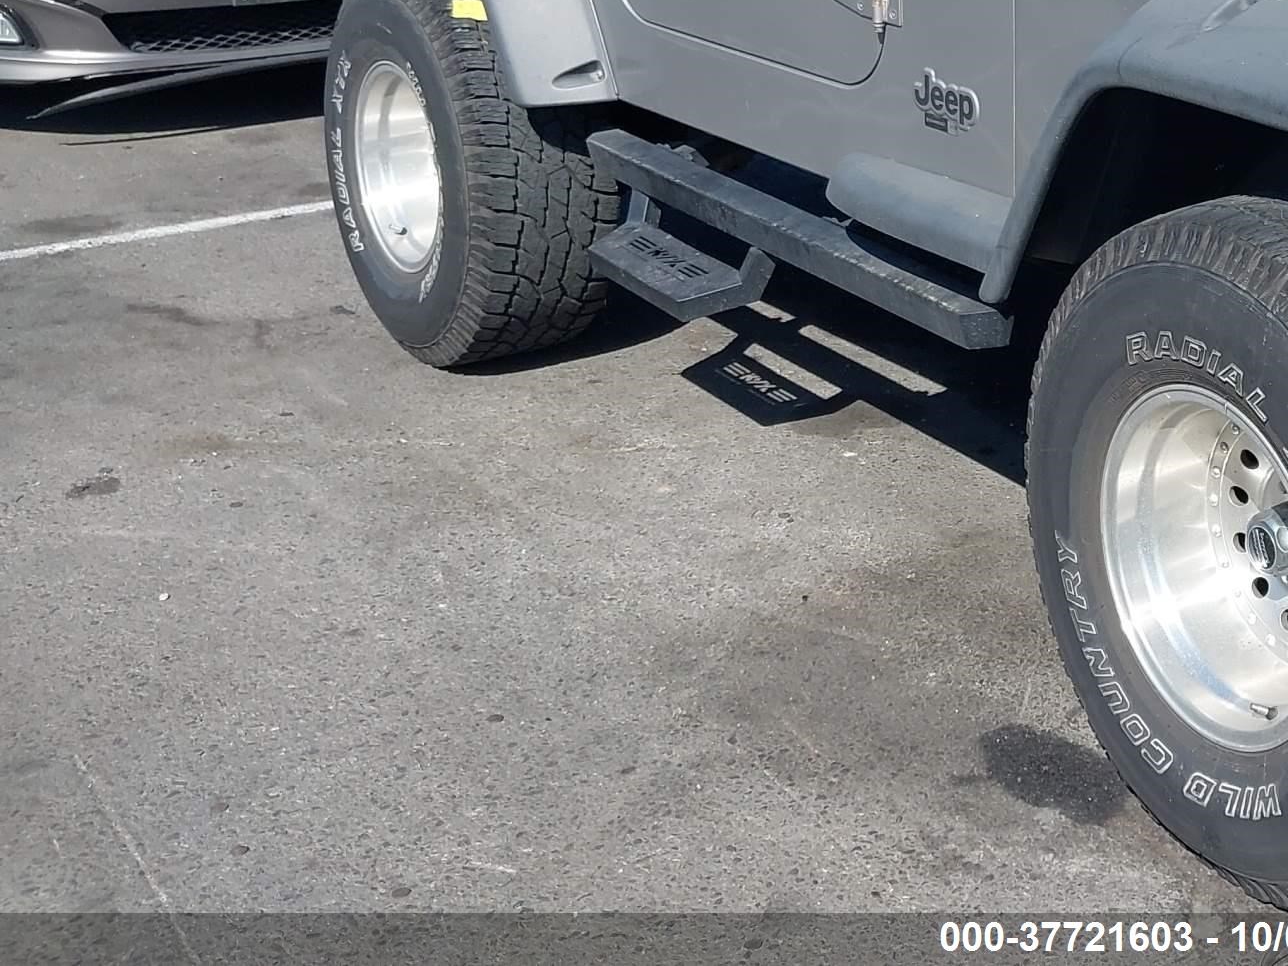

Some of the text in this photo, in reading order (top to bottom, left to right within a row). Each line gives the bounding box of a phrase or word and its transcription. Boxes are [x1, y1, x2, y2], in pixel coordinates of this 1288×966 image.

[914, 72, 975, 126] Jeep
[1125, 330, 1269, 425] RADIAL
[1054, 530, 1282, 820] WILD COUNTRY
